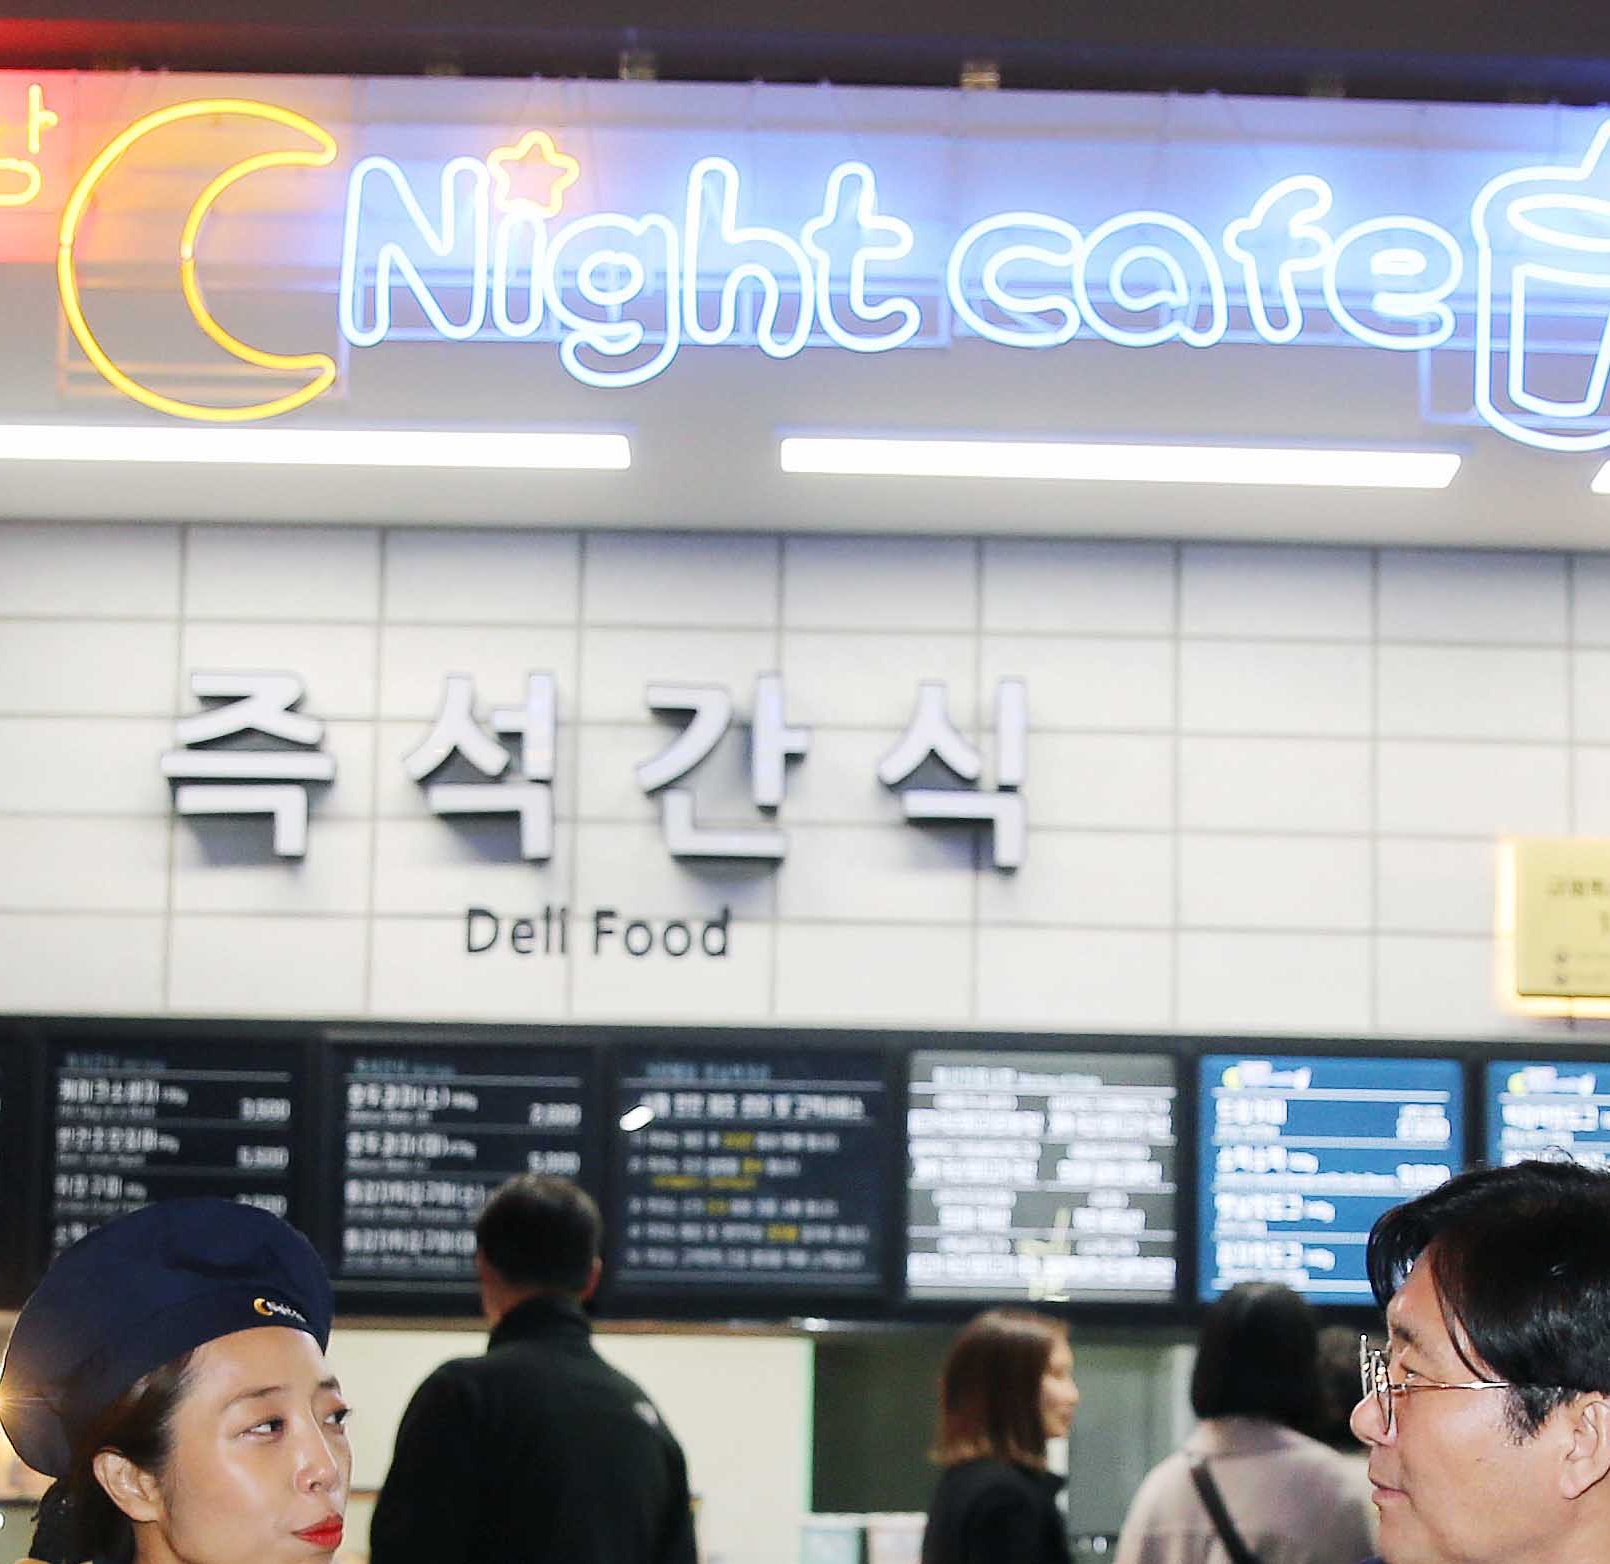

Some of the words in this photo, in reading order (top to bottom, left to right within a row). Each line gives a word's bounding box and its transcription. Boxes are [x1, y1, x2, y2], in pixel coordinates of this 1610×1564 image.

[339, 130, 921, 389] Night
[946, 172, 1464, 351] cafe
[160, 672, 1028, 872] 즉석간식
[592, 904, 733, 959] Food
